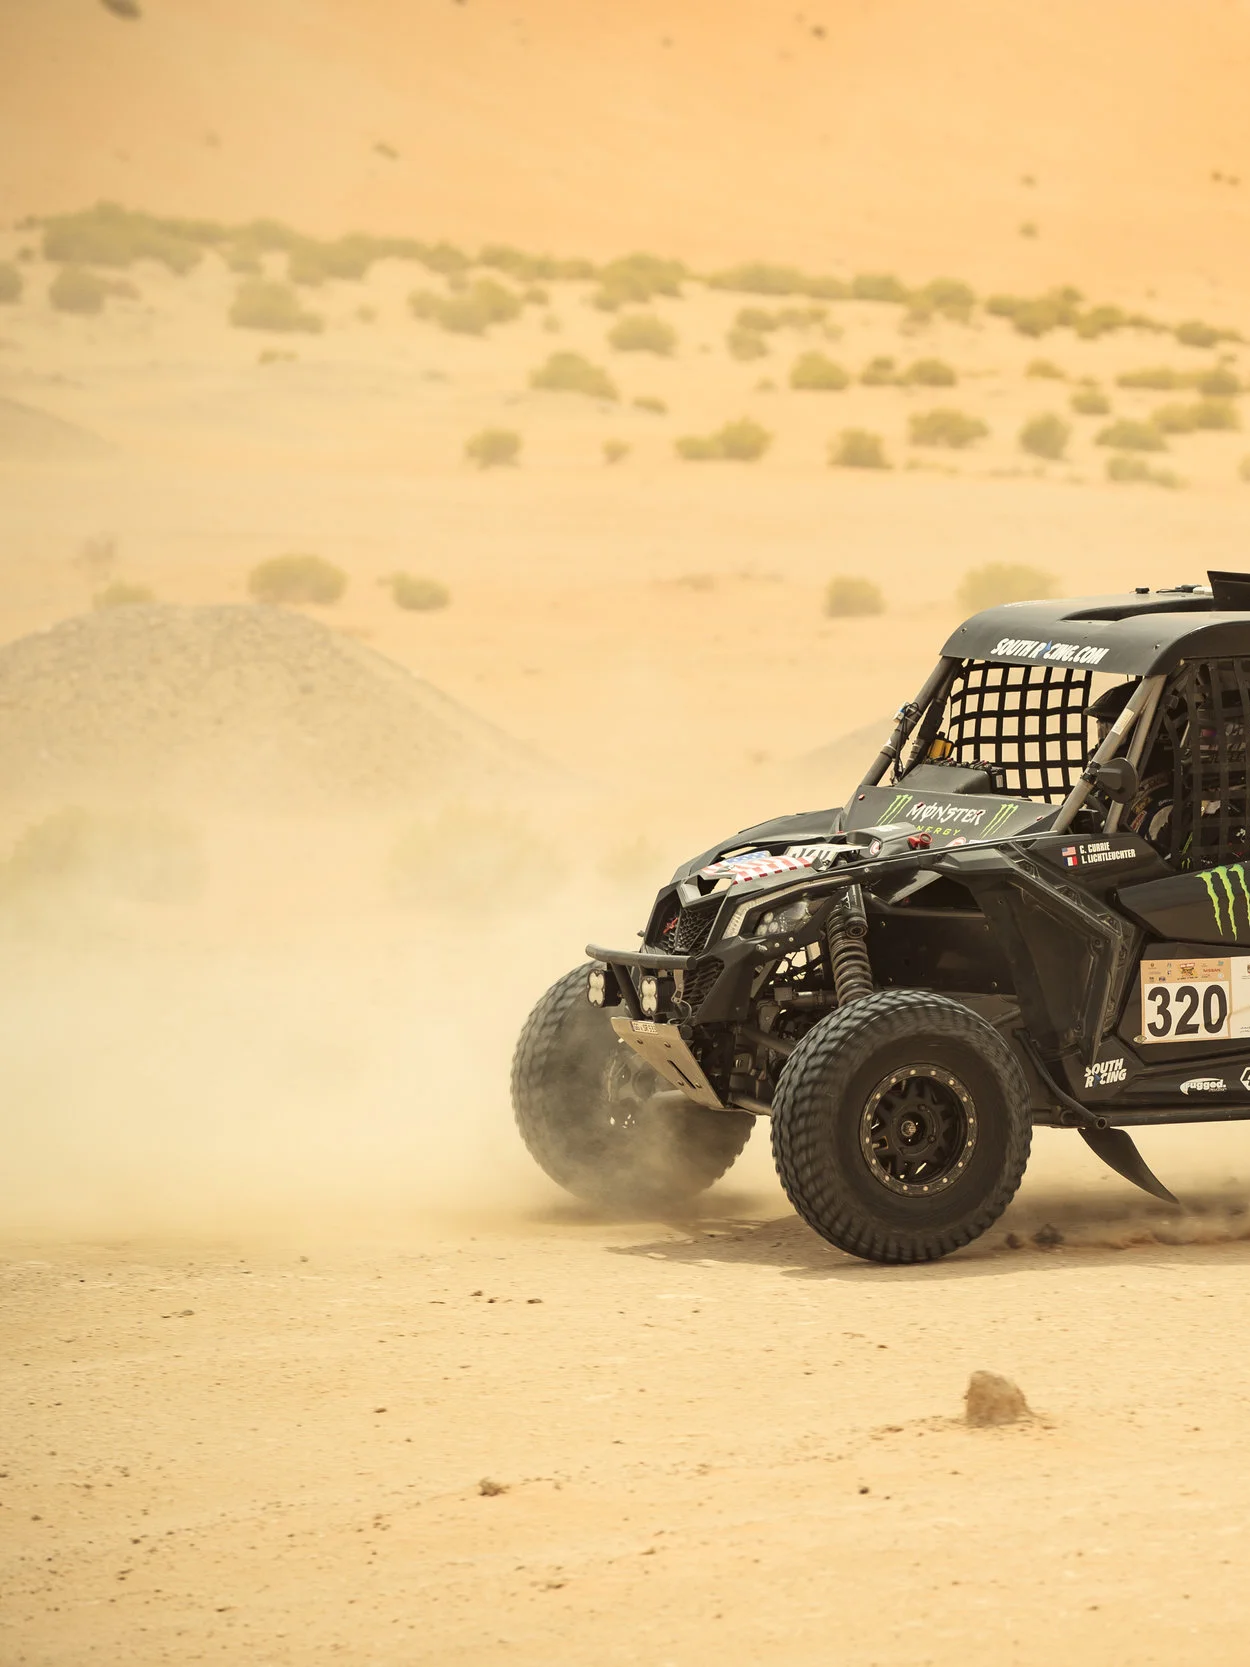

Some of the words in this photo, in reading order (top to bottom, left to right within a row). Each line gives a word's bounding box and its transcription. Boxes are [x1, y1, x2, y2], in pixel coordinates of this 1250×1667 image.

[915, 825, 962, 836] NERGY
[1087, 841, 1111, 853] CURRIE
[1147, 984, 1228, 1038] 320
[1084, 1058, 1124, 1077] SOUTH
